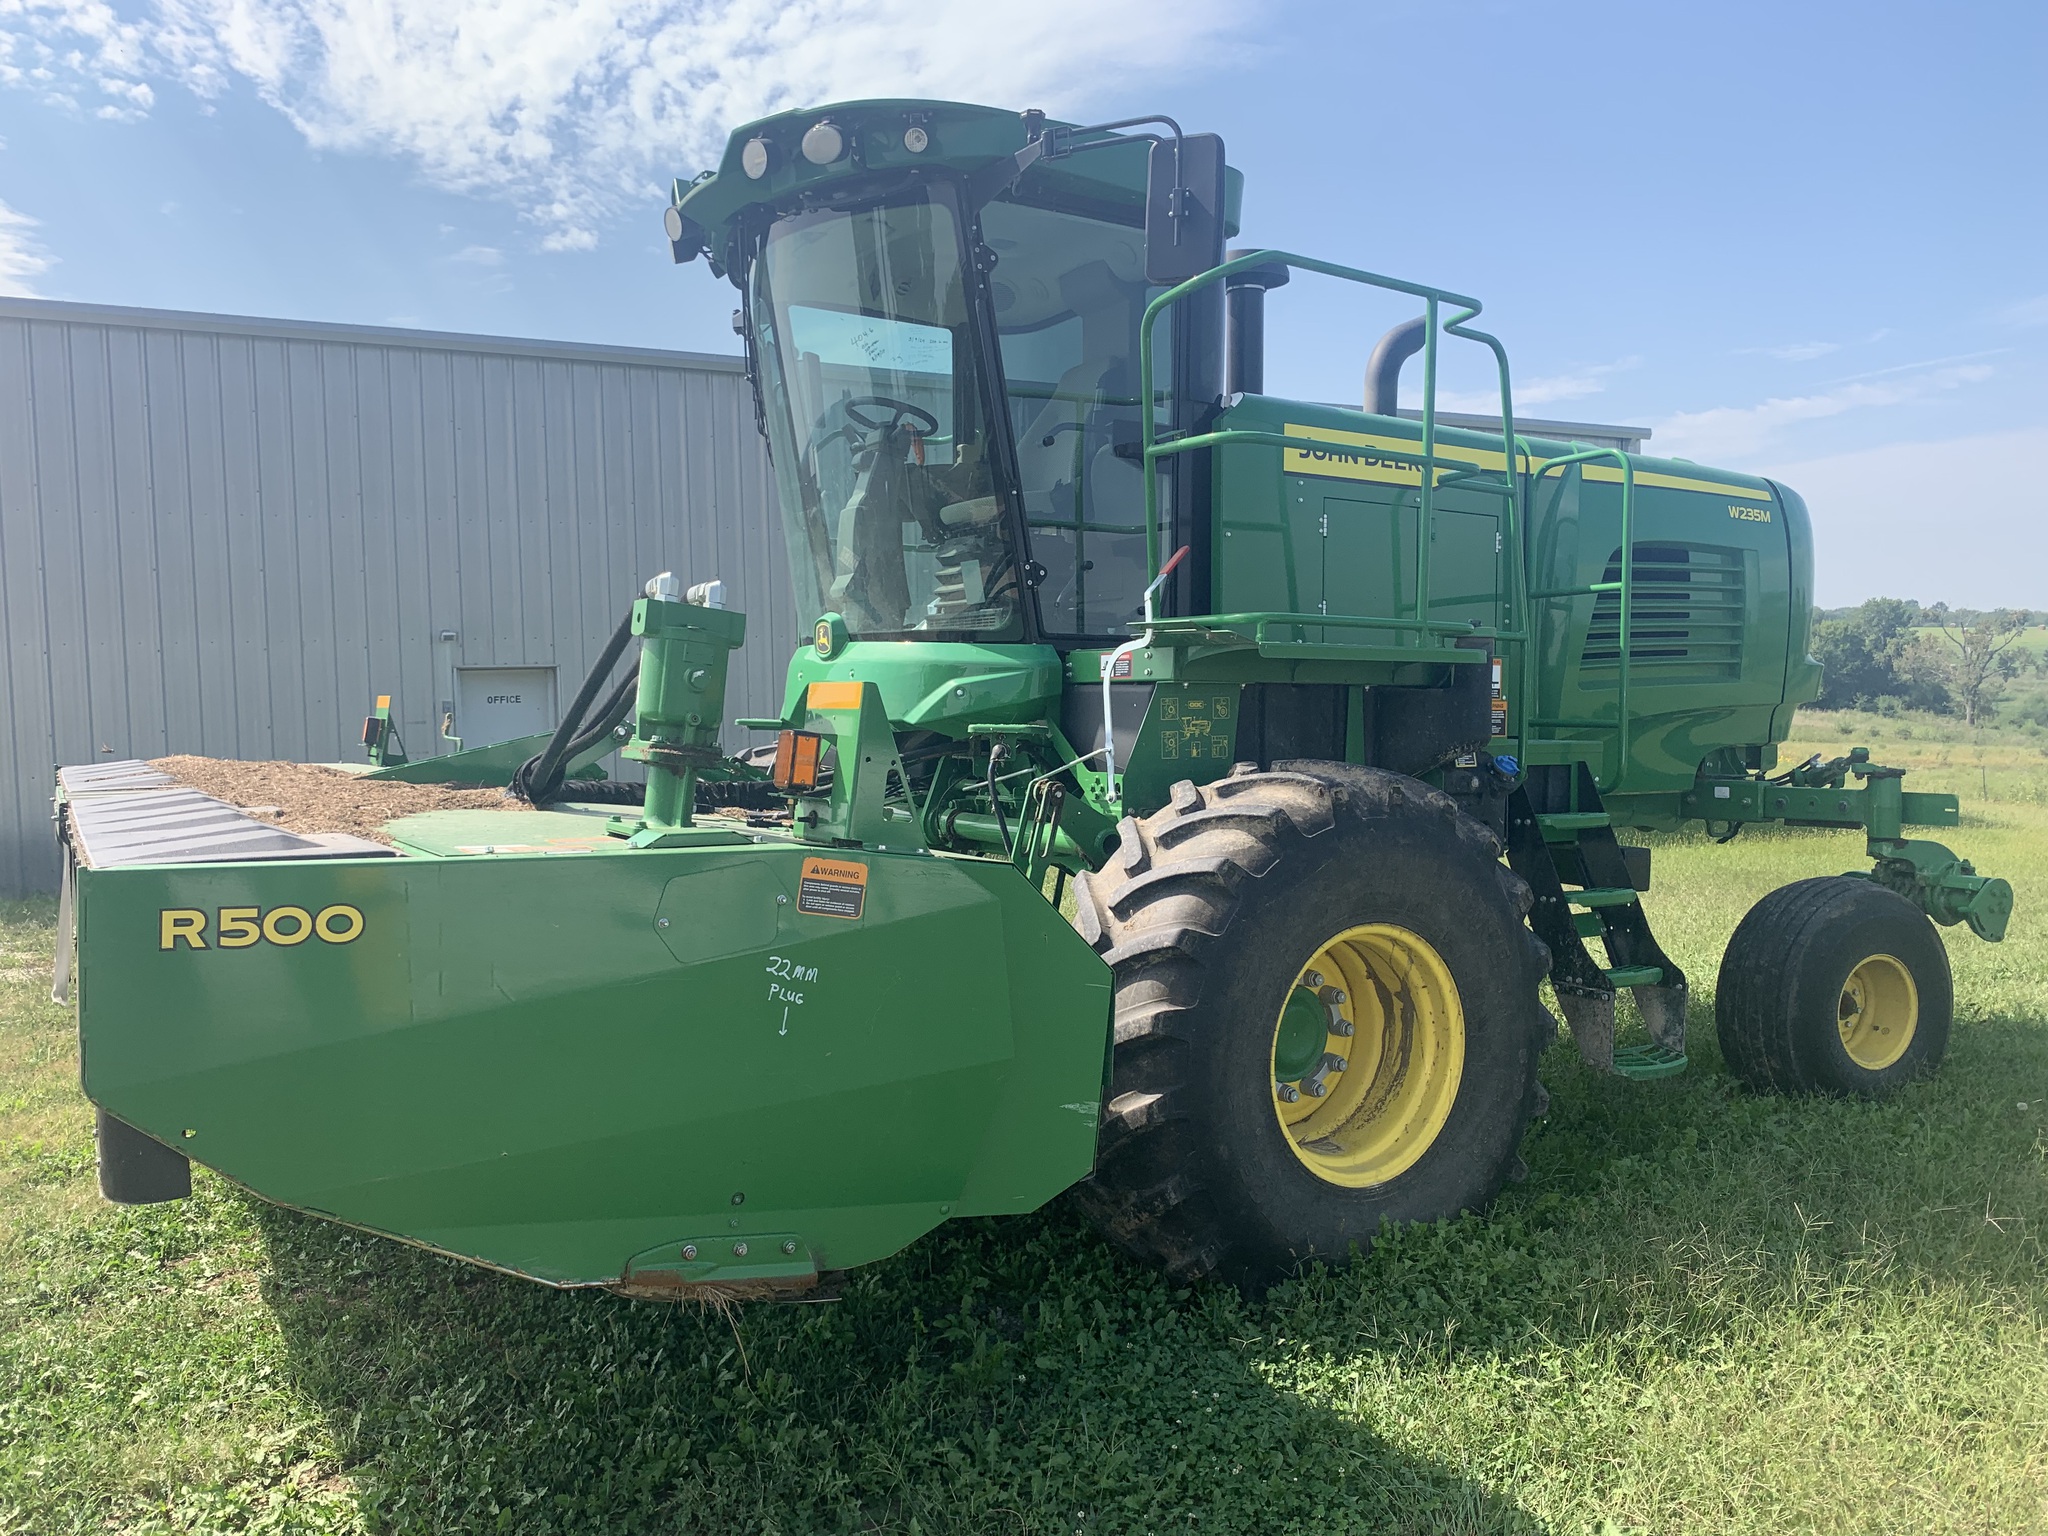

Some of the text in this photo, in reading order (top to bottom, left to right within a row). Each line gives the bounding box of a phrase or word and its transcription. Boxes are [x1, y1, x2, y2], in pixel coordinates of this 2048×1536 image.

[1727, 505, 1771, 523] W235M
[487, 695, 522, 704] OFFICE
[820, 867, 860, 879] WARNING
[159, 903, 365, 951] R500
[765, 956, 818, 983] 22MM
[768, 983, 804, 1005] PLUG
